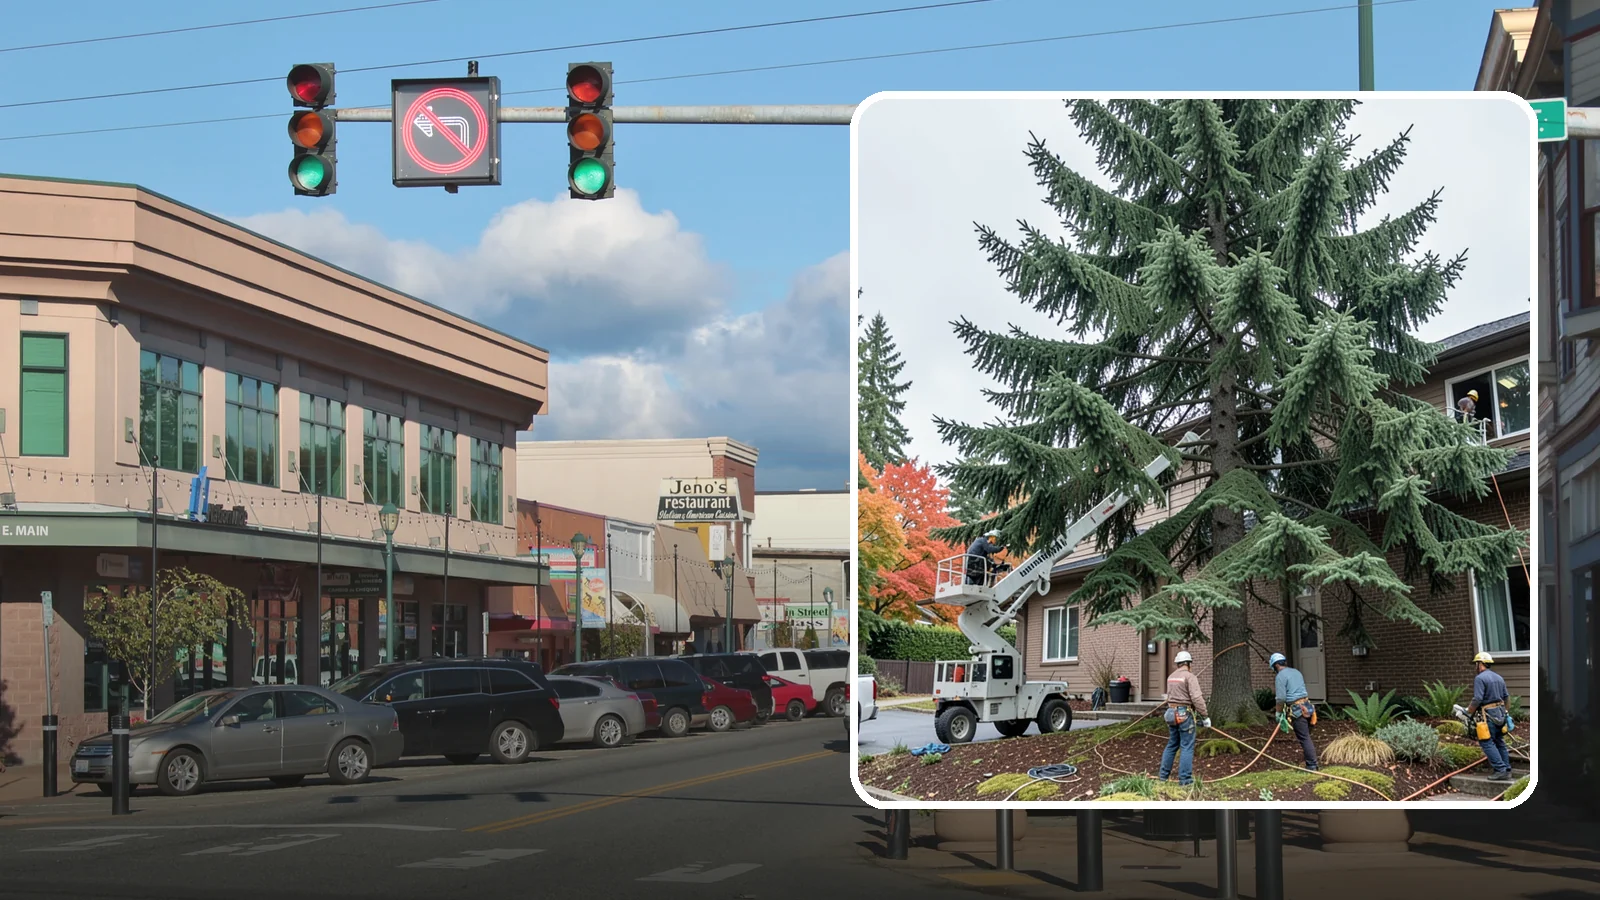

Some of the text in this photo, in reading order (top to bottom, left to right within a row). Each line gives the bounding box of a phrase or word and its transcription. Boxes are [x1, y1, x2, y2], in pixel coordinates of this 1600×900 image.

[669, 480, 728, 494] Jeno's
[665, 496, 731, 509] restaurant
[658, 509, 682, 520] Italian
[686, 509, 715, 519] American
[714, 509, 738, 519] Cuisine
[2, 525, 49, 536] E. MAIN
[786, 607, 828, 616] in Street
